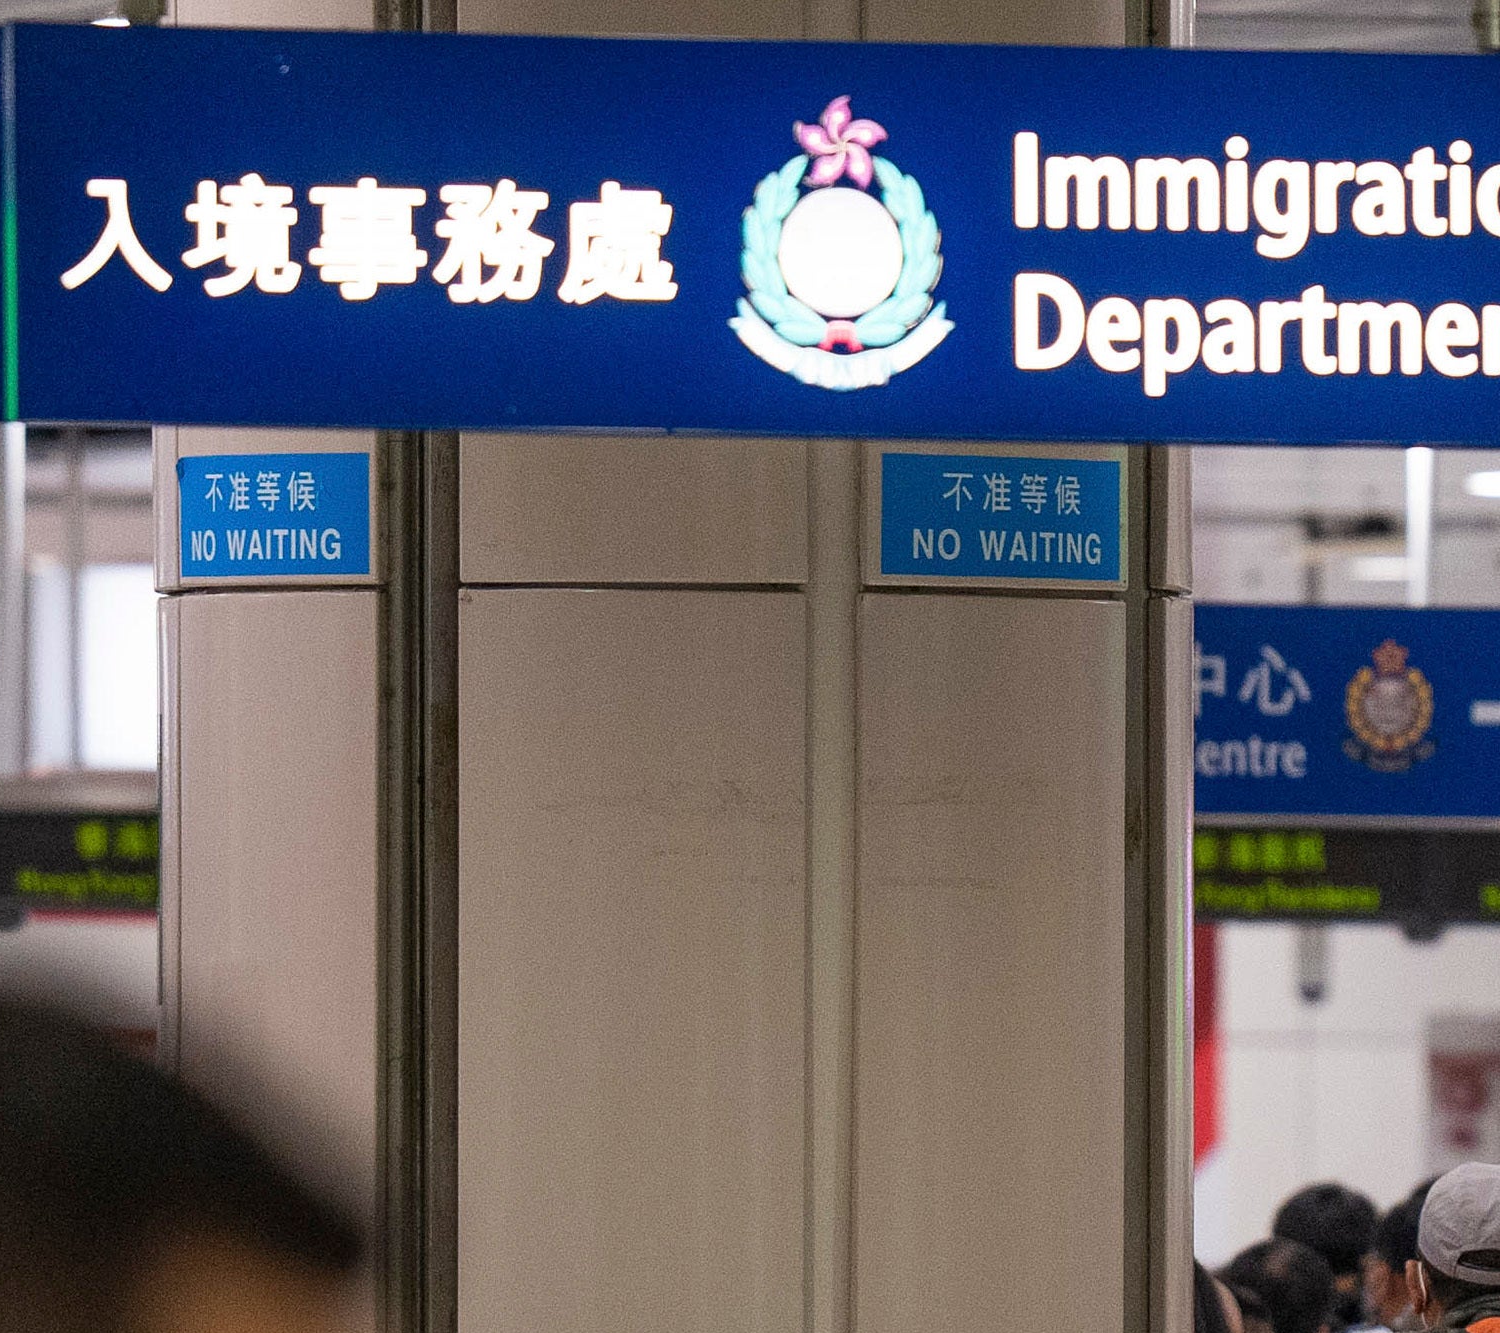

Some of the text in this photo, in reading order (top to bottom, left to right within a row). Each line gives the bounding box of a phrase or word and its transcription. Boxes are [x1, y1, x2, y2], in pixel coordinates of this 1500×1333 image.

[60, 172, 680, 305] 入境事務處
[204, 469, 318, 514] 不准等候
[941, 471, 1083, 517] 不准等候
[190, 526, 342, 563] NO WAITING
[911, 526, 1103, 567] NO WAITING
[1194, 733, 1308, 778] entre
